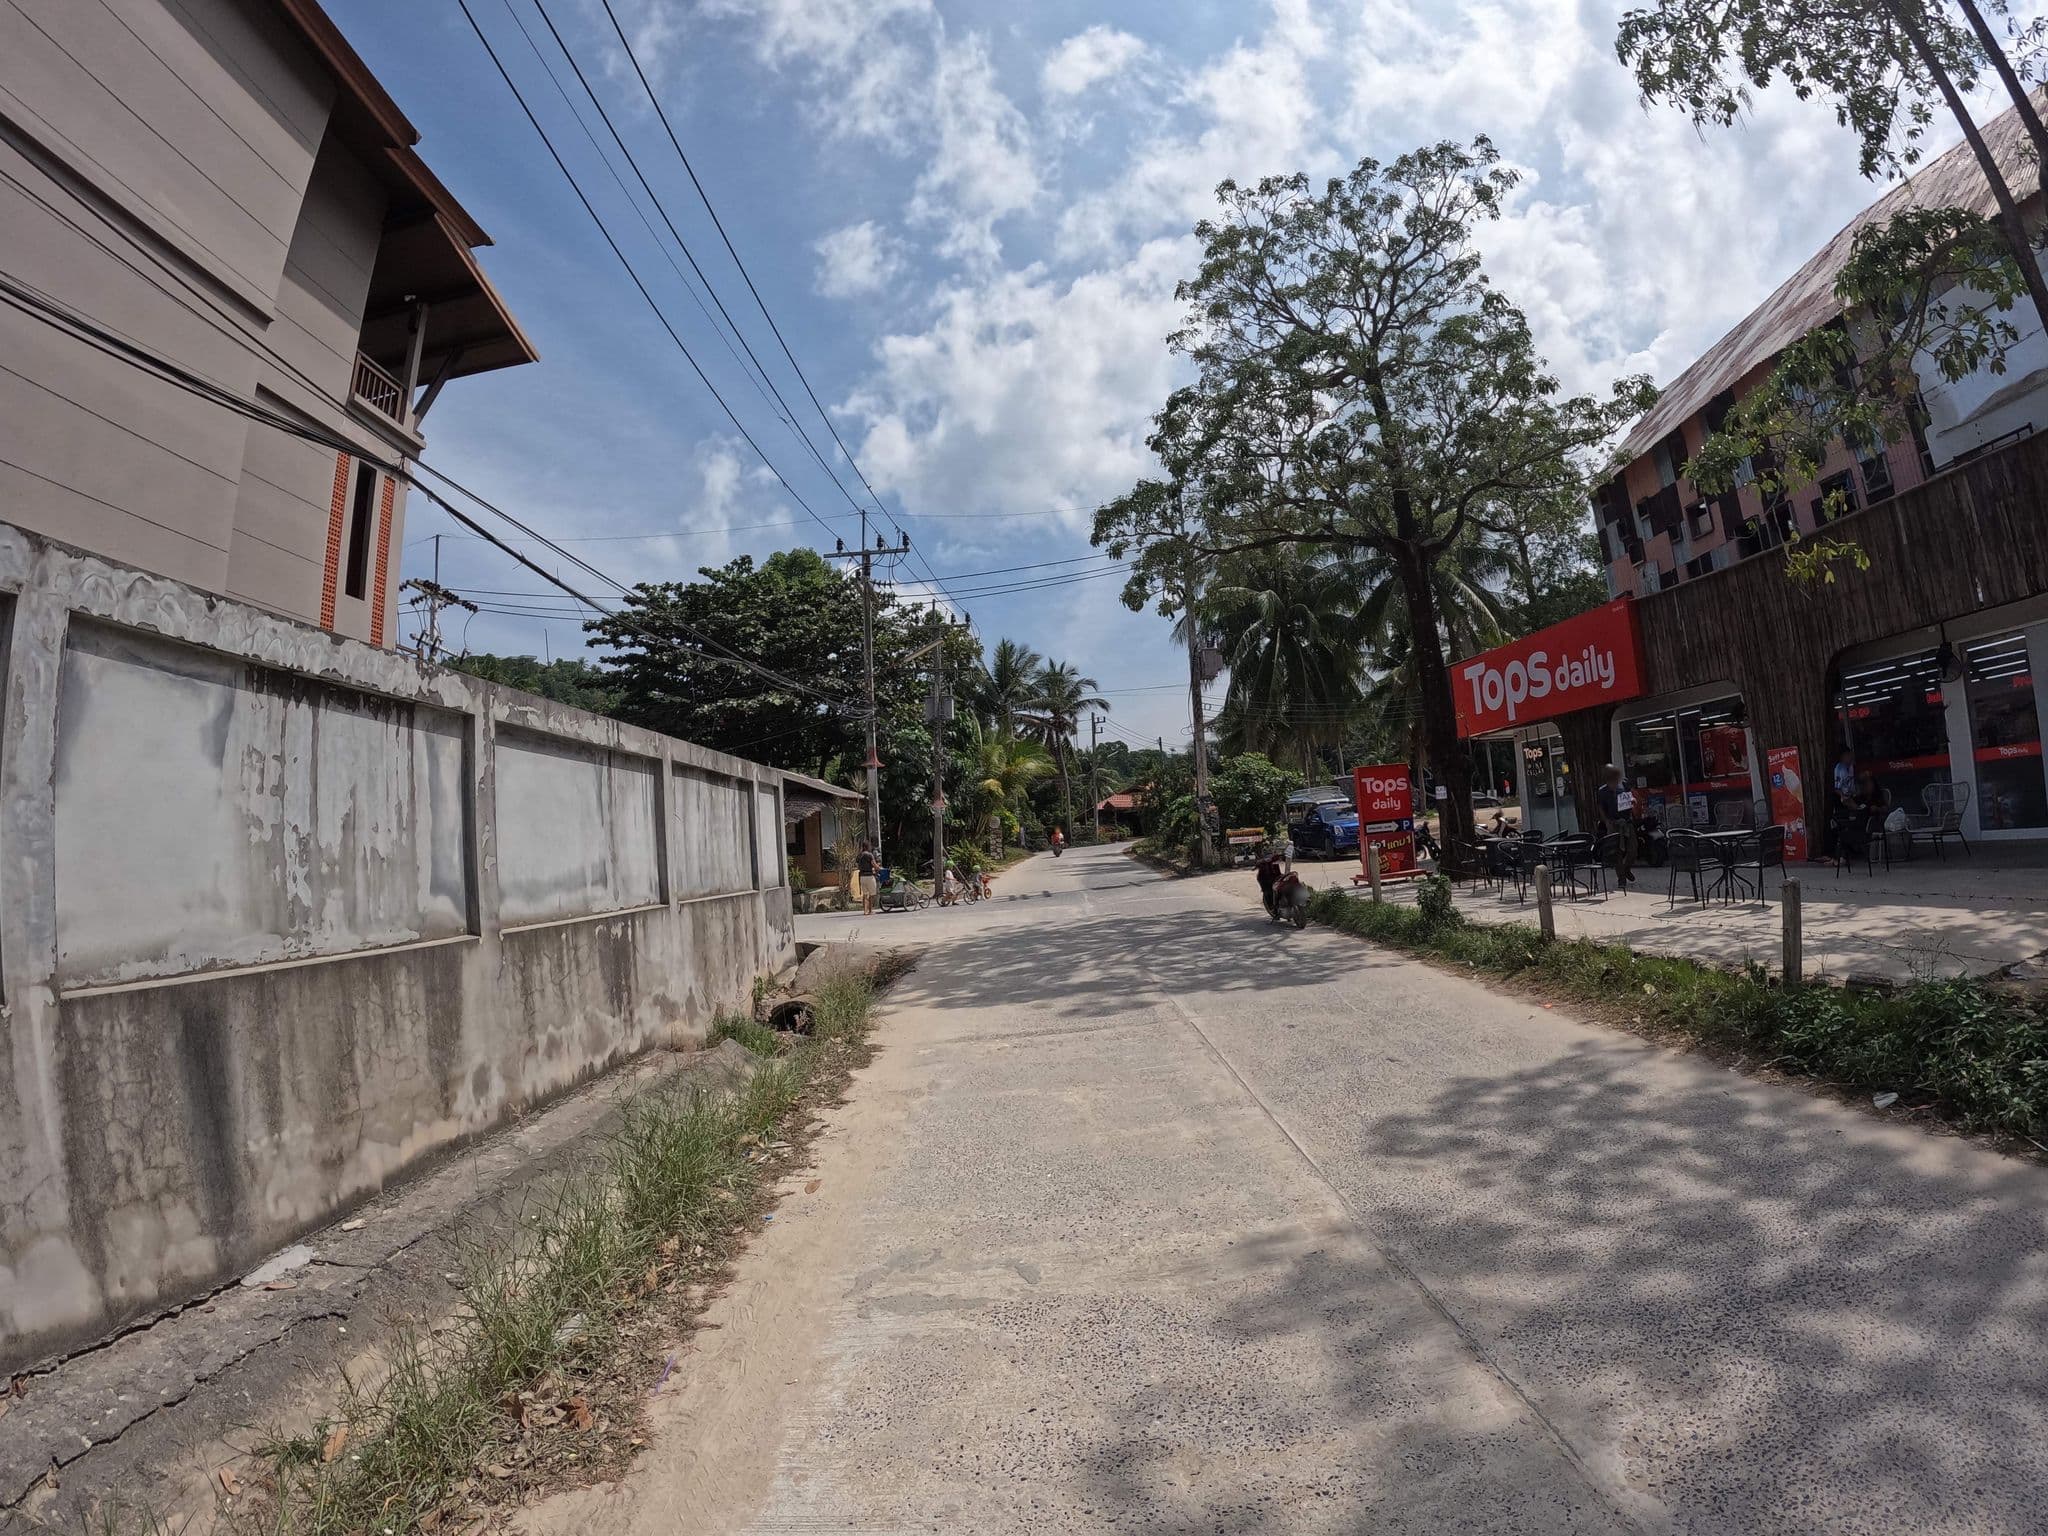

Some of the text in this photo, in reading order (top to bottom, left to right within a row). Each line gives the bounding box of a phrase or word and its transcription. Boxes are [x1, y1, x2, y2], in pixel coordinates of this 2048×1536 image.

[1463, 644, 1616, 721] Tops daily
[1523, 747, 1543, 760] Tops
[1361, 777, 1408, 796] Tops
[1372, 798, 1401, 811] daily
